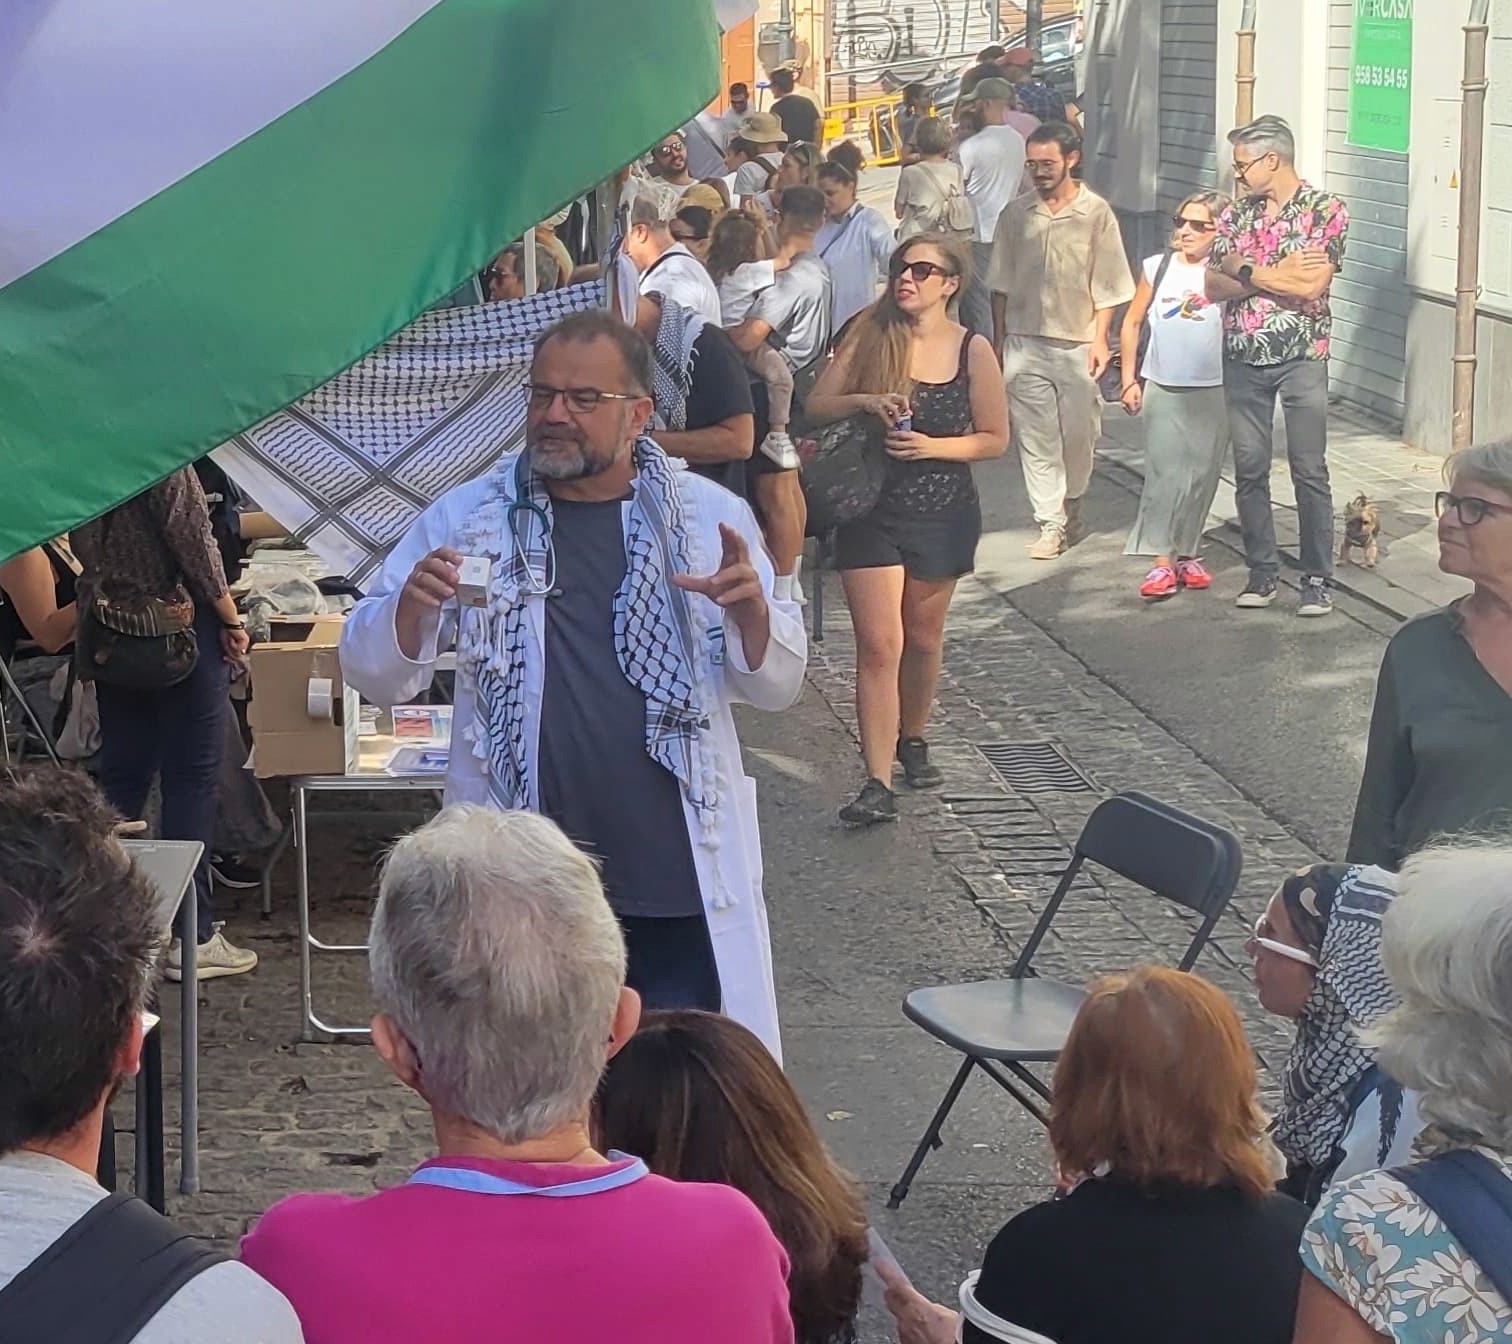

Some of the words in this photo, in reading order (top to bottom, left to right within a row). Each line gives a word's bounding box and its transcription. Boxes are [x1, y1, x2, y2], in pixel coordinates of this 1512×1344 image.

[1355, 65, 1370, 84] 958
[1372, 65, 1383, 86] 53
[1383, 67, 1395, 88] 54
[1396, 68, 1408, 89] 55
